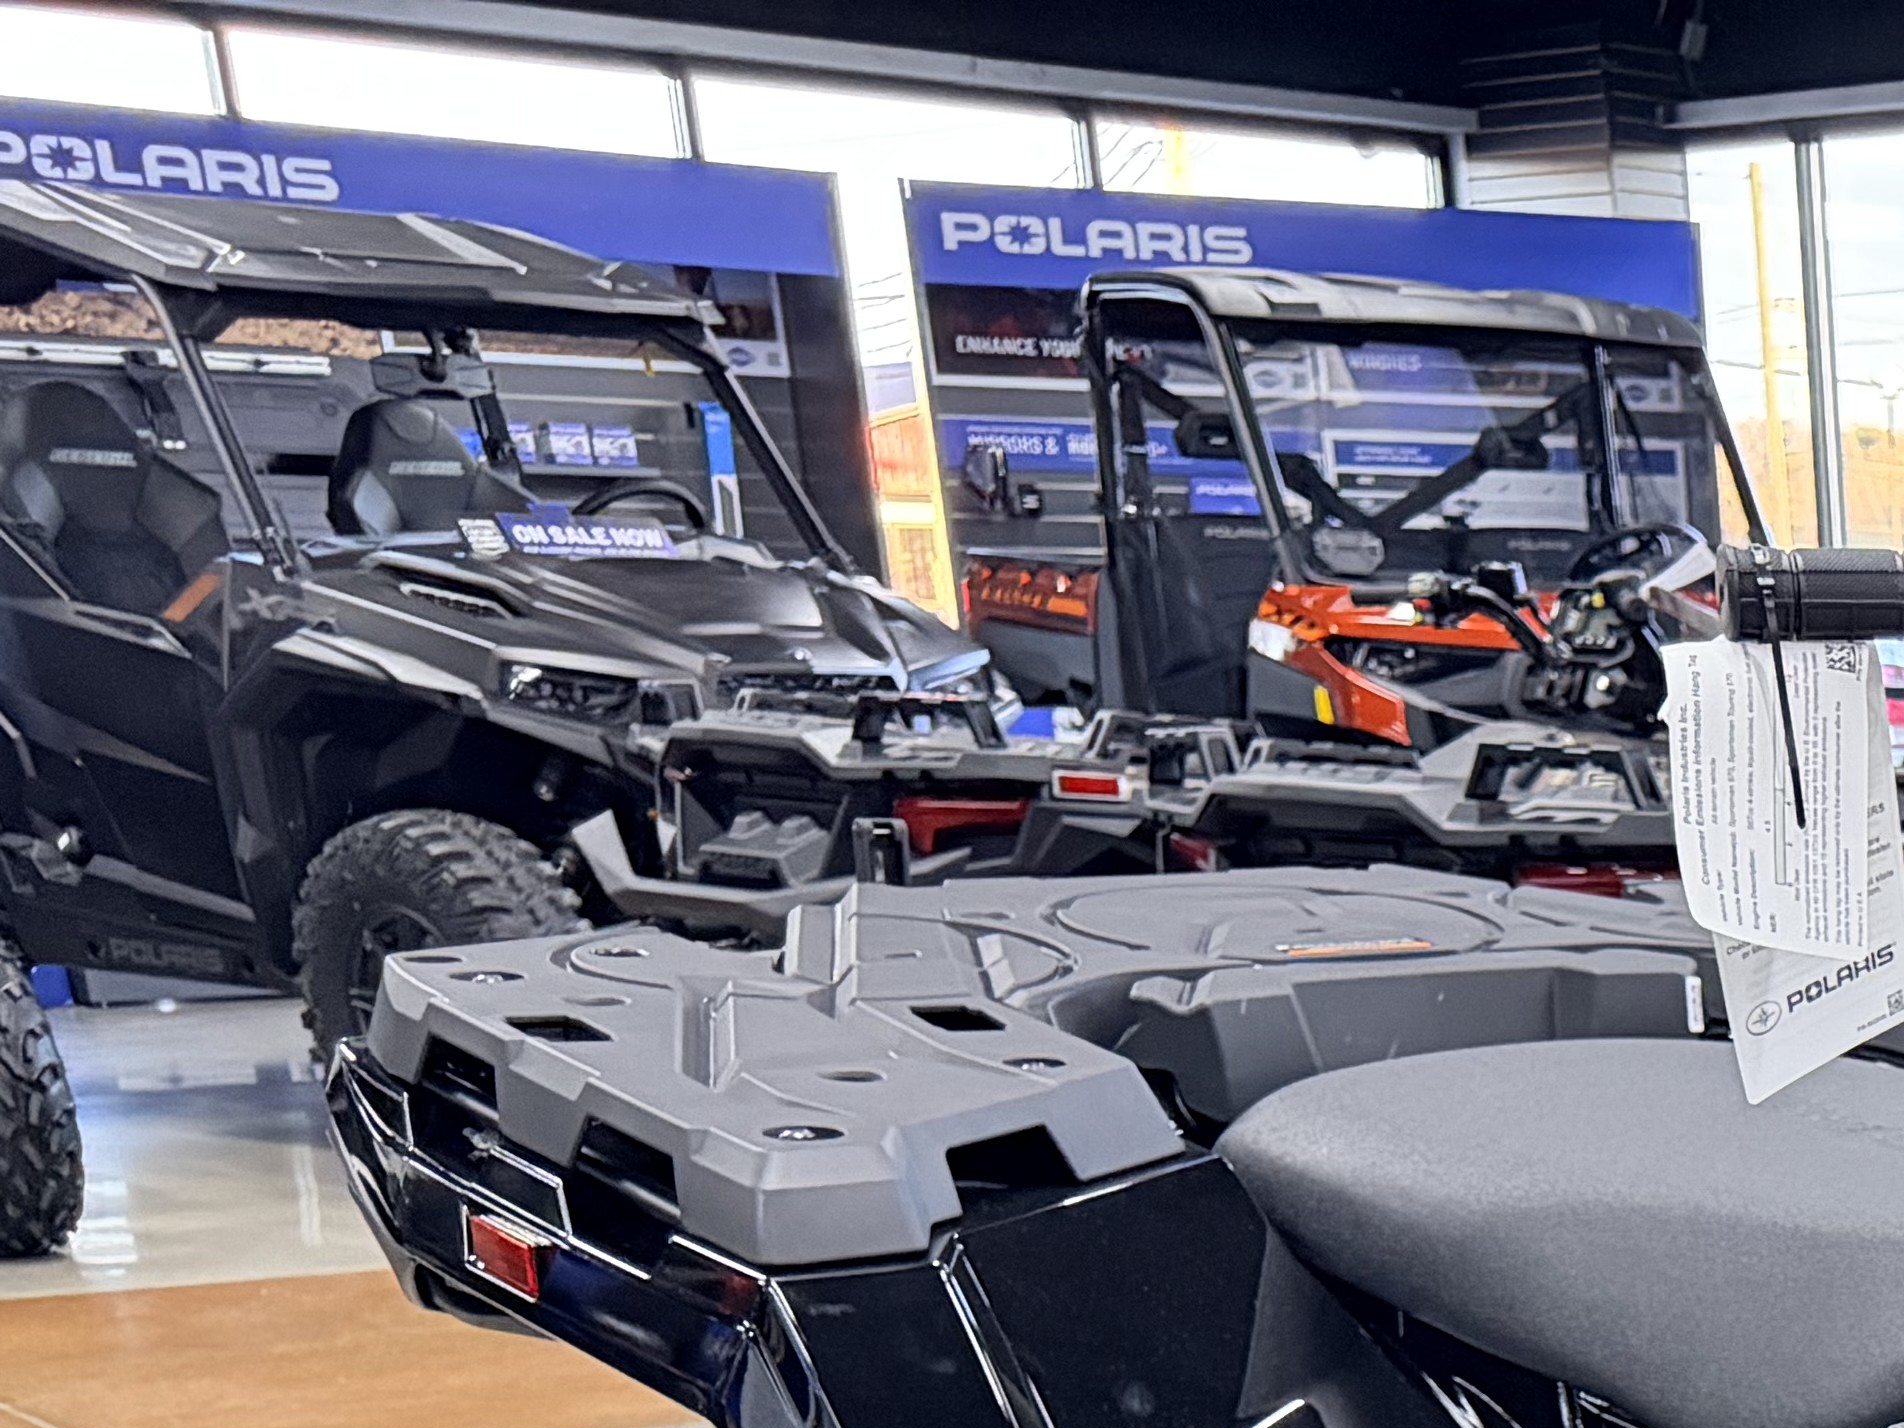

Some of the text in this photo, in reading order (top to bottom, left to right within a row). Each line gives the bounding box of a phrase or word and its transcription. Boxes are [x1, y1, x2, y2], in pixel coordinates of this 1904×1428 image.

[941, 212, 1253, 264] POLARIS
[548, 525, 612, 546] SALE
[1690, 671, 1701, 697] Hang
[1679, 727, 1690, 783] Industries
[1692, 700, 1702, 765] Information
[1682, 786, 1692, 824] Polaris
[1693, 768, 1705, 826] Emissions
[1698, 830, 1710, 886] Consumer
[1787, 944, 1896, 1014] POLARIS
